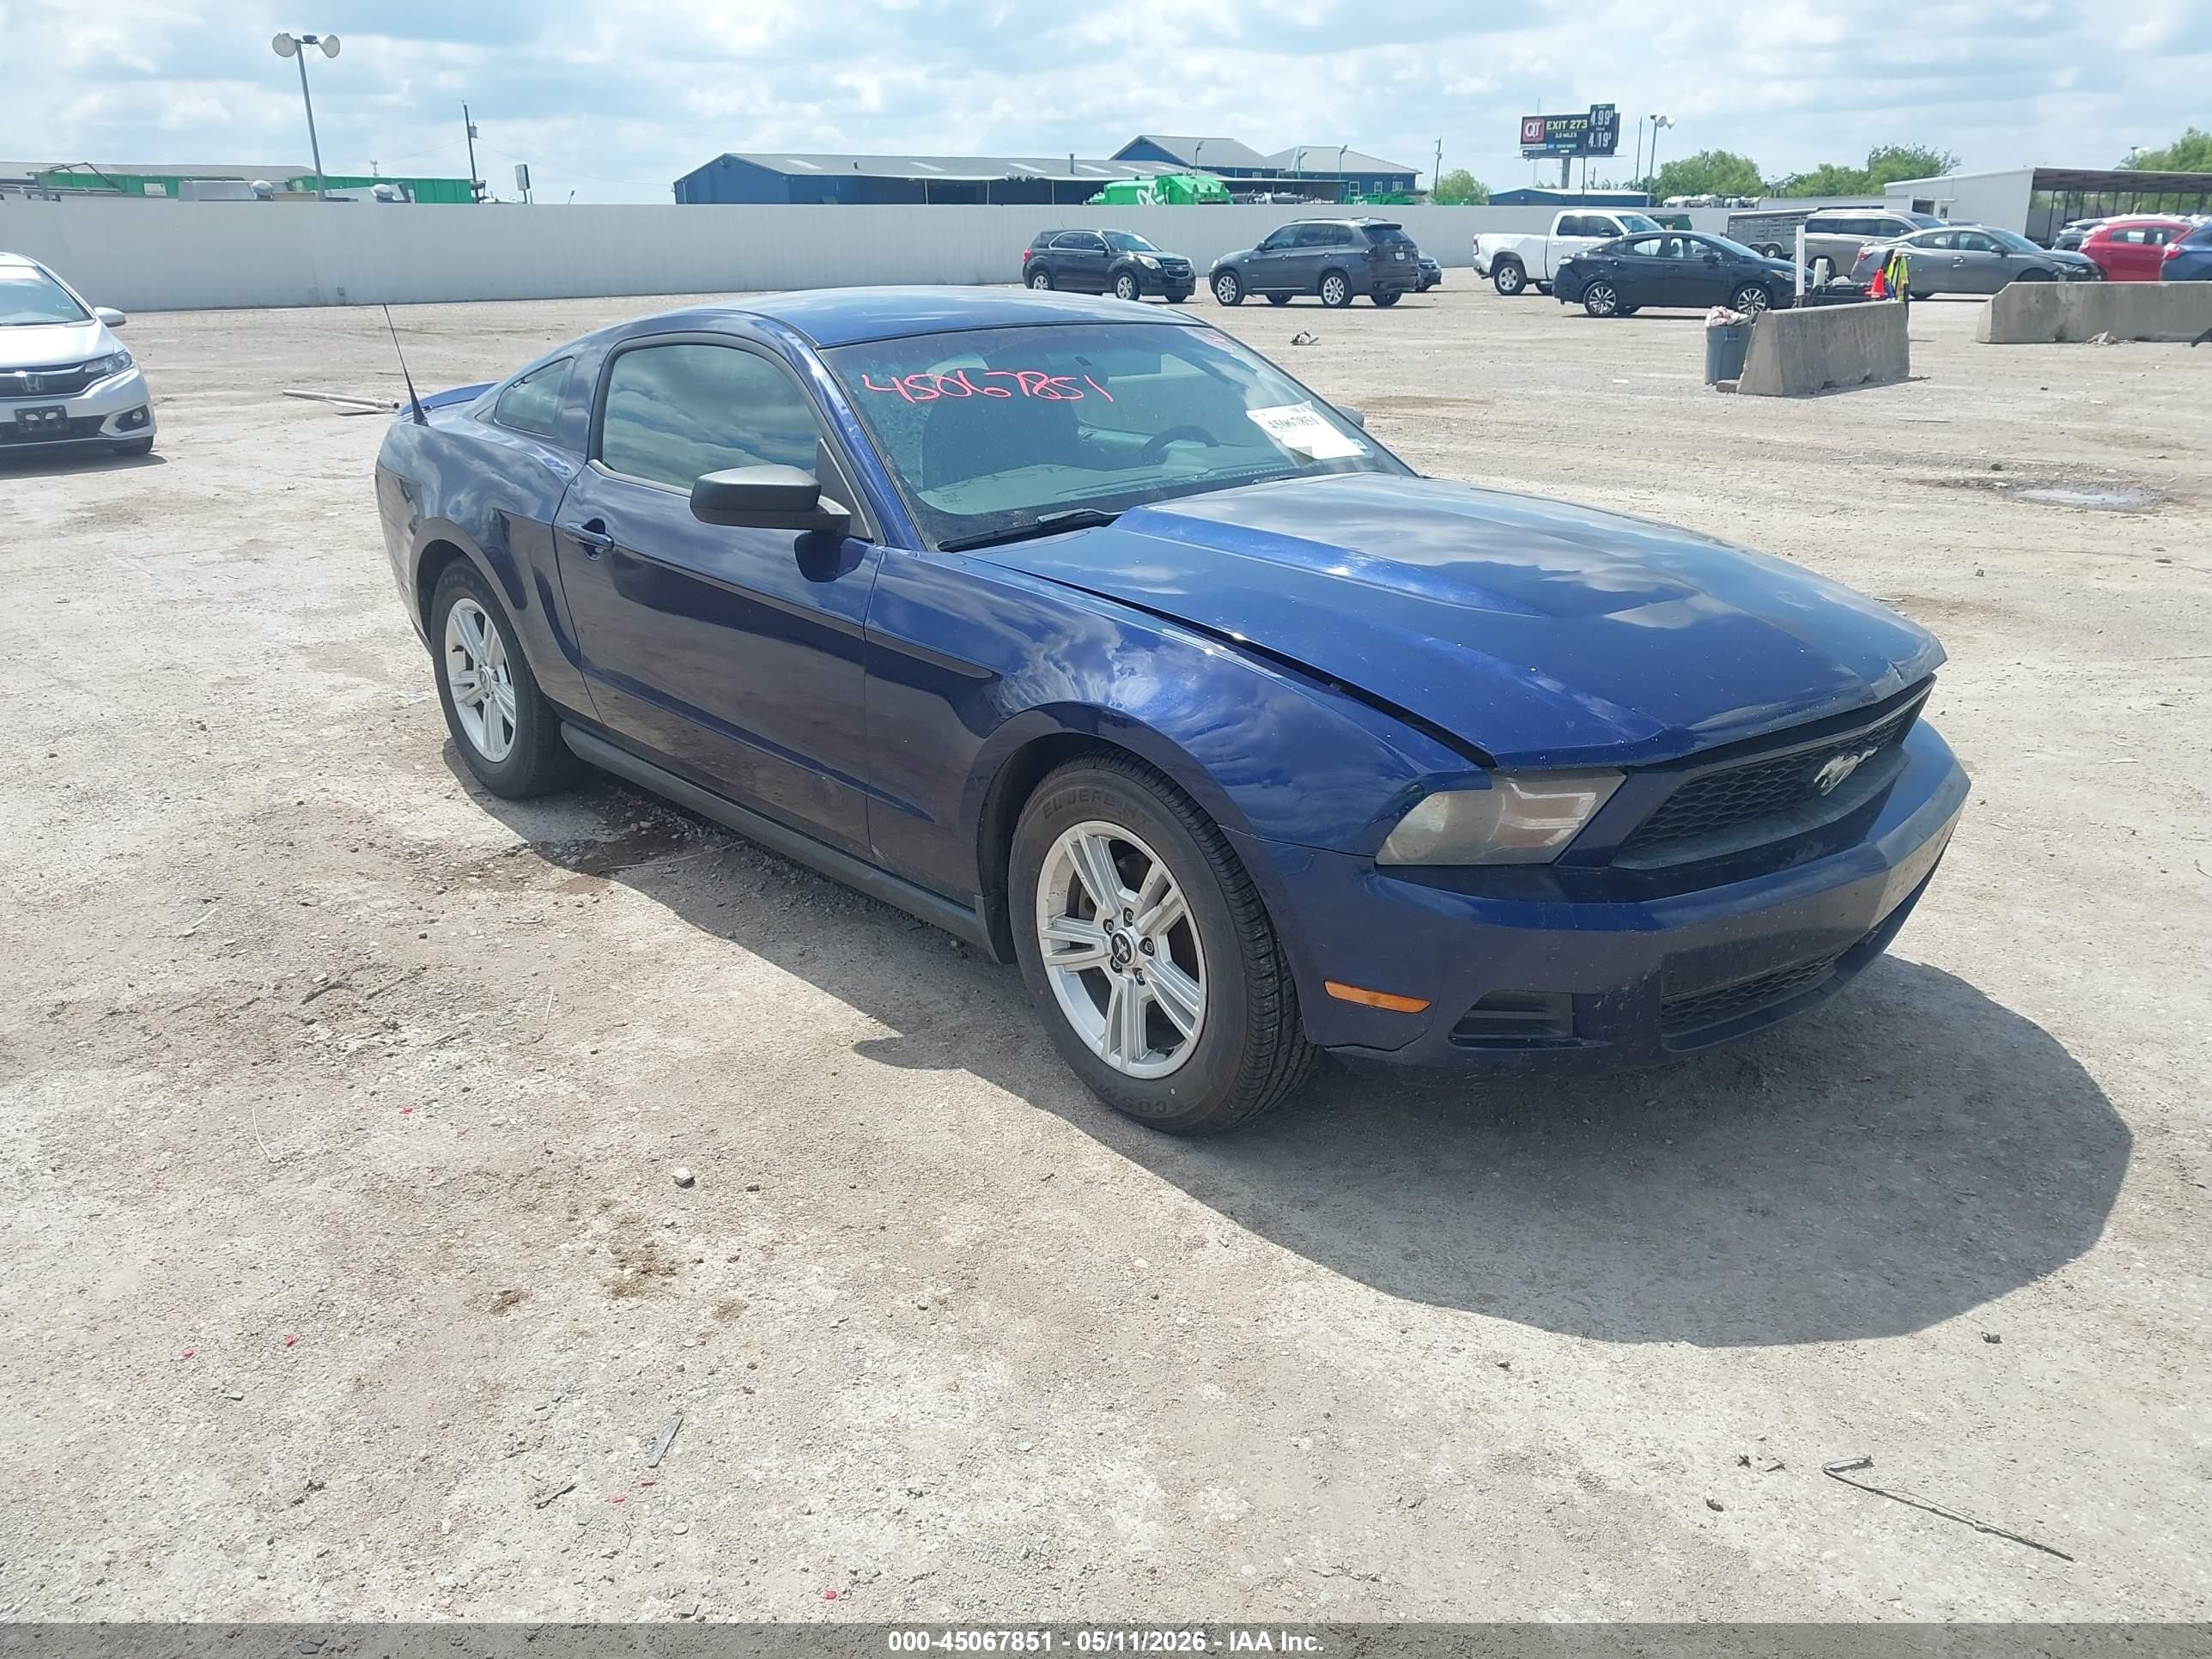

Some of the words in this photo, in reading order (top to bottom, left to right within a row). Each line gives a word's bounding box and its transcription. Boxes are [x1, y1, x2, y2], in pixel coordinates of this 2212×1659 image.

[1525, 122, 1541, 137] QT
[1546, 120, 1567, 131] EXIT
[1569, 119, 1588, 130] 273
[861, 370, 1114, 404] 45067851
